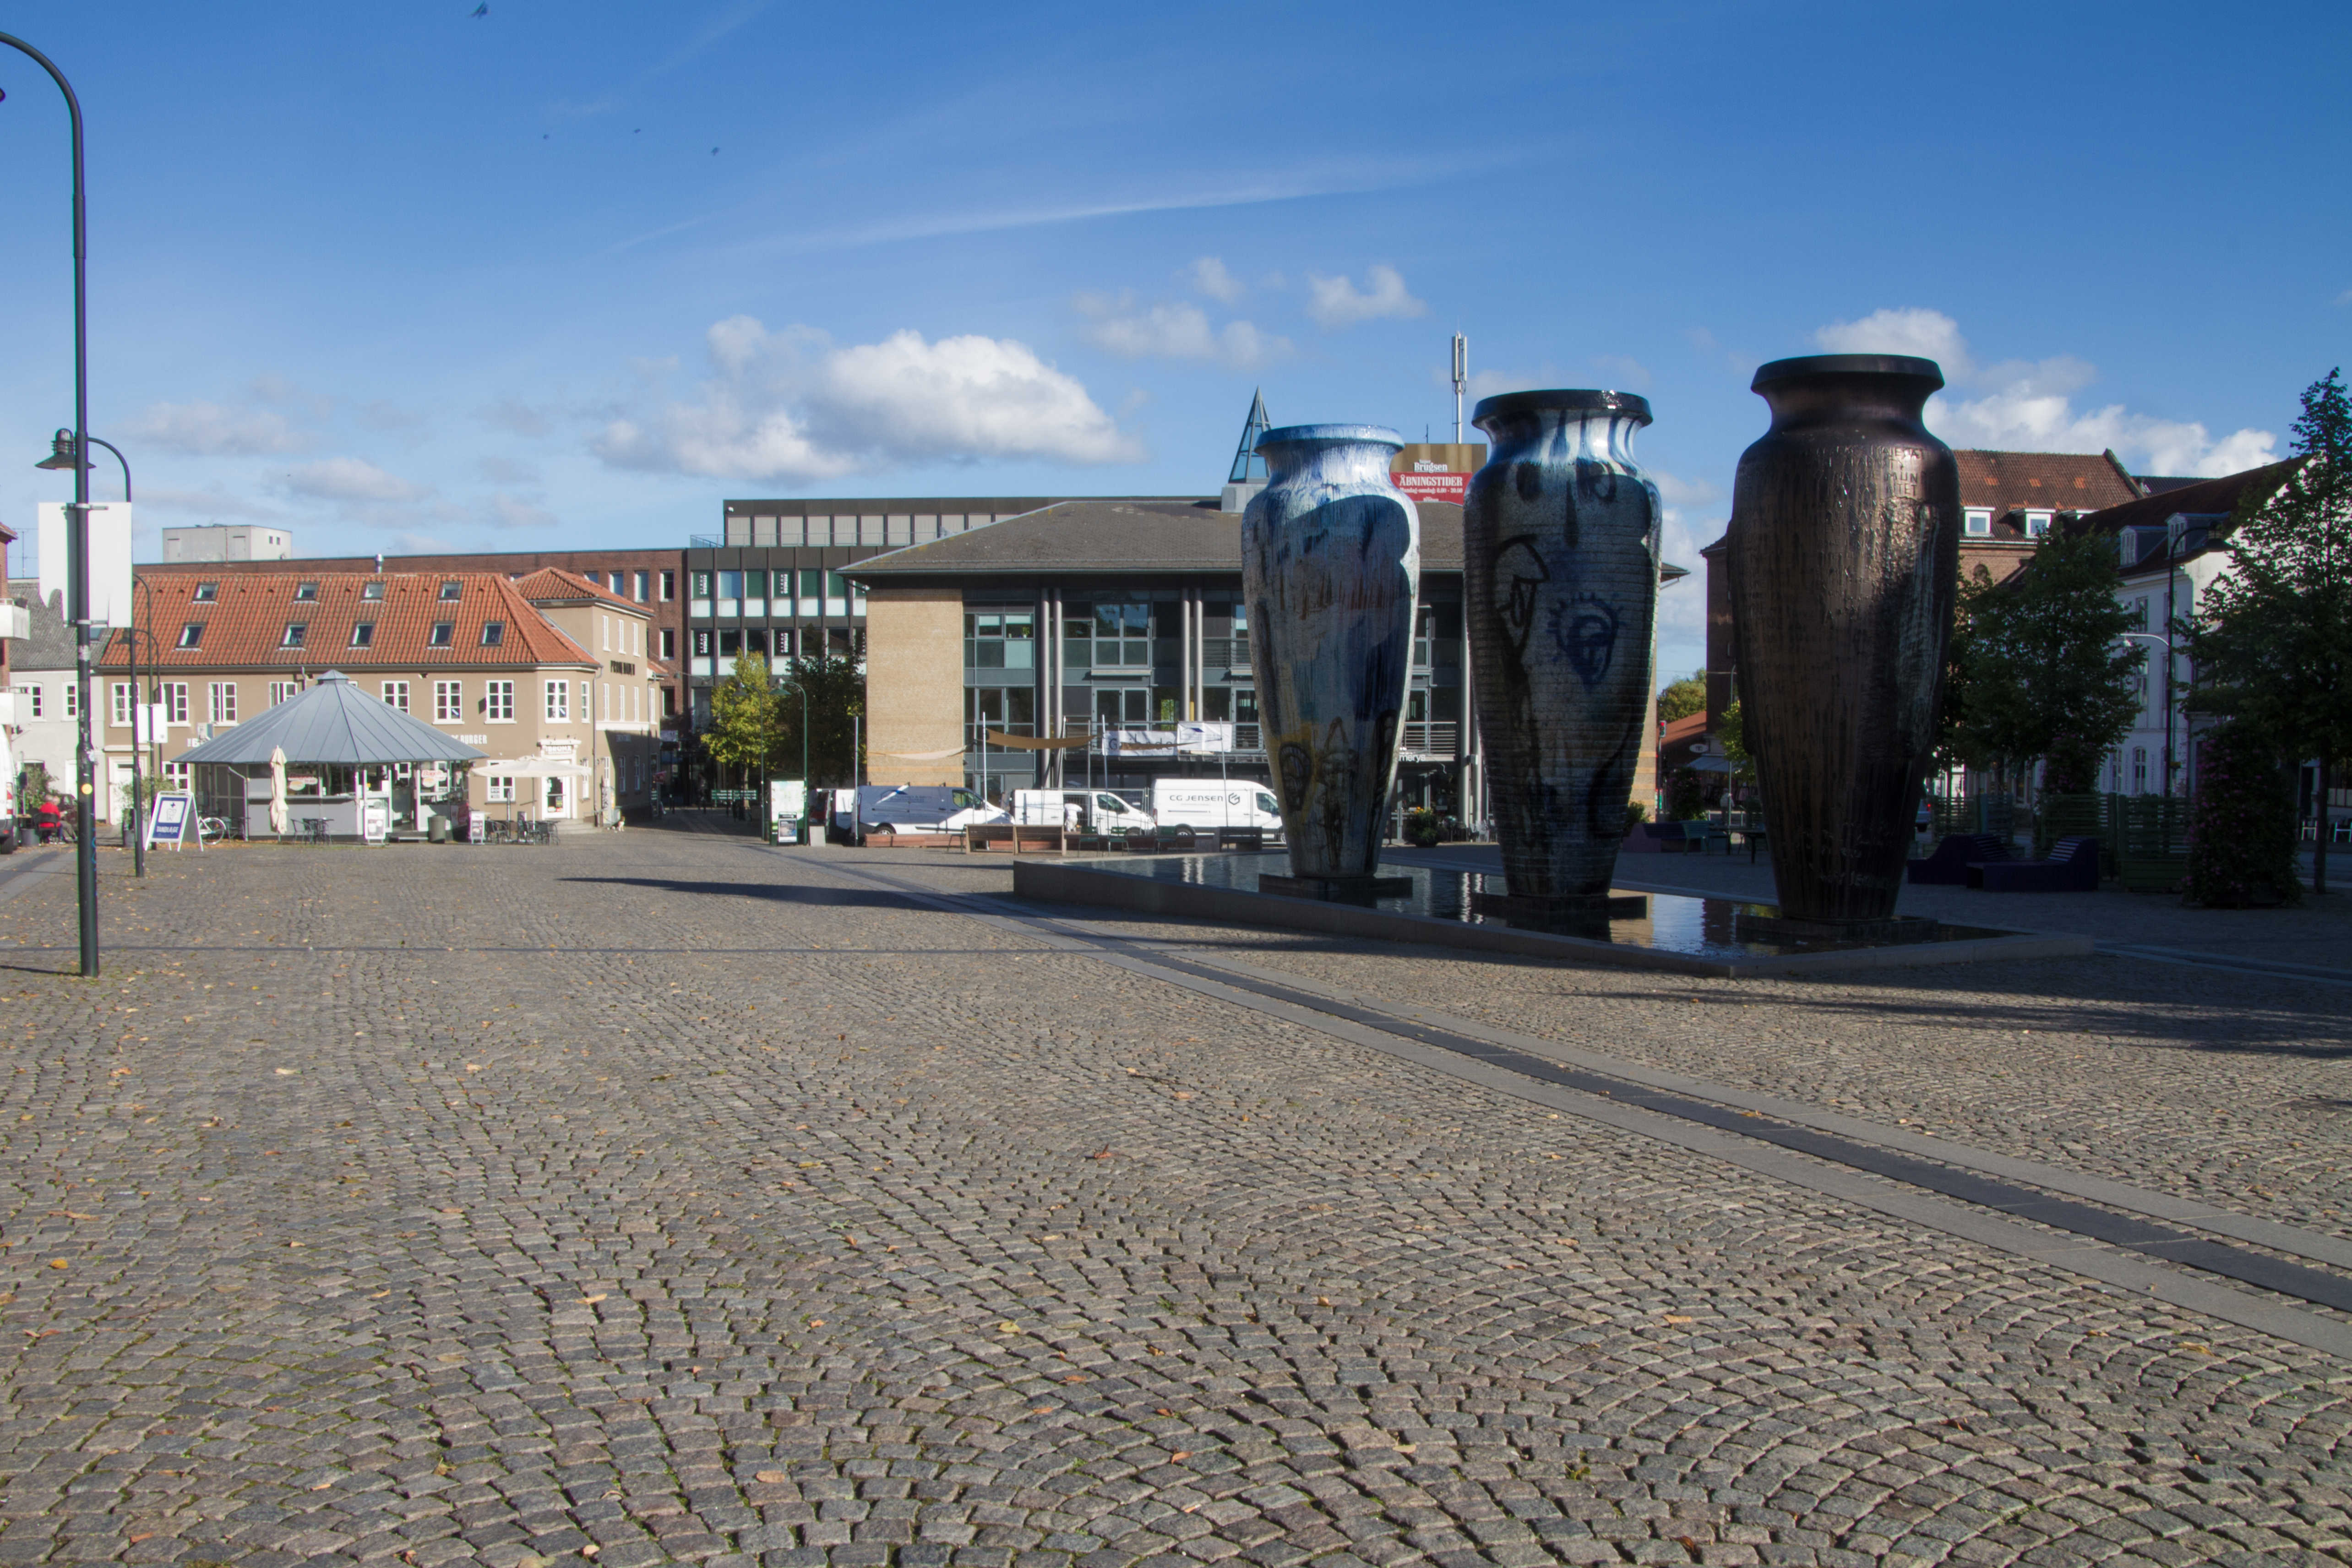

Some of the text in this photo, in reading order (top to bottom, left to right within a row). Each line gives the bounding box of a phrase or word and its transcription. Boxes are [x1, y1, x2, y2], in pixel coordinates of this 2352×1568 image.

[1414, 462, 1448, 473] Brugsen
[1399, 474, 1463, 486] ÅBNINGSTIDER
[460, 734, 487, 745] BURGER
